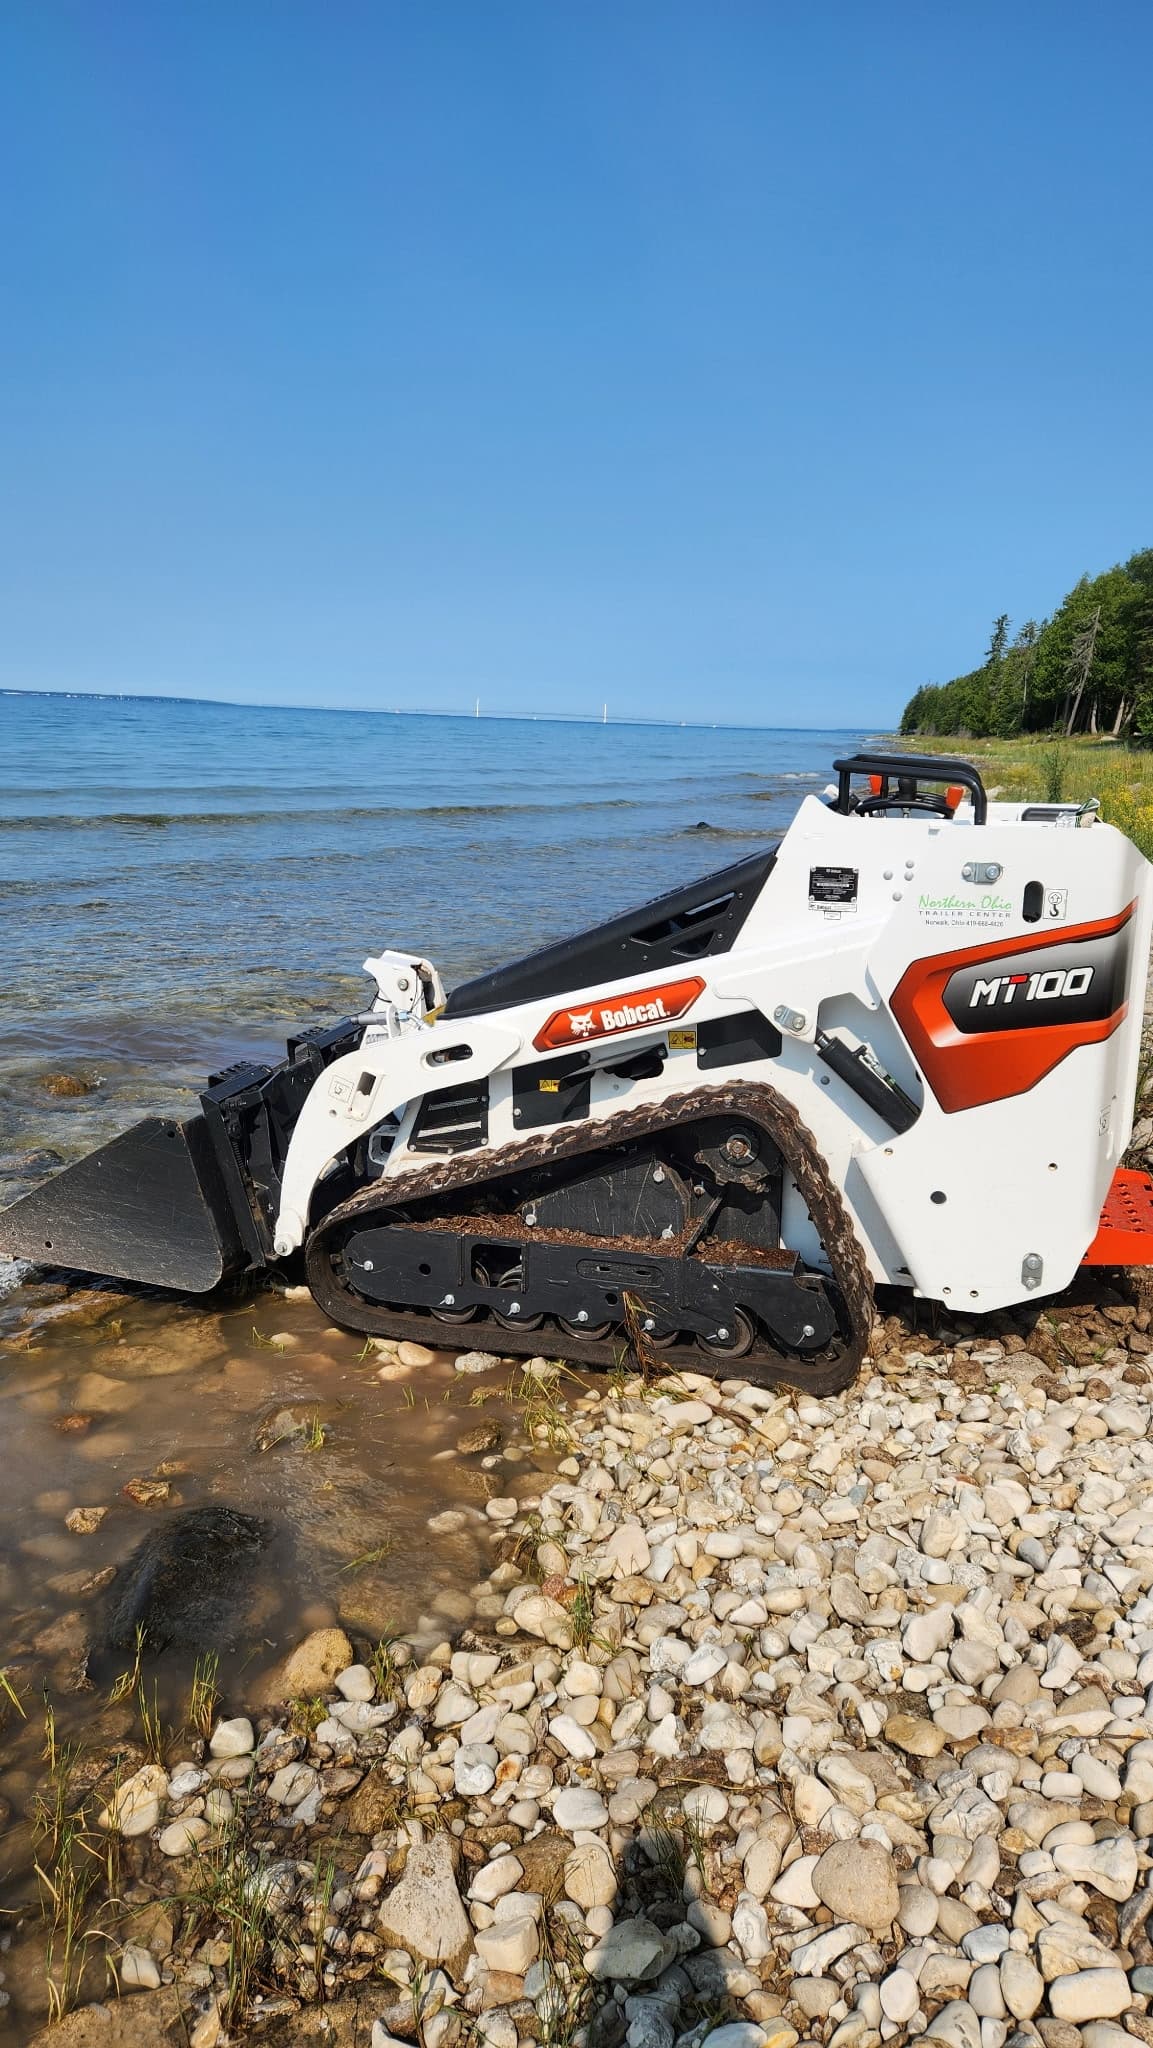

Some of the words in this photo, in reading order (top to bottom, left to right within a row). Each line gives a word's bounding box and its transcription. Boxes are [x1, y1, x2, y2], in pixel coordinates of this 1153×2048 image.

[919, 894, 976, 908] Northern
[981, 895, 1012, 910] Ohio
[969, 967, 1093, 1007] MT100
